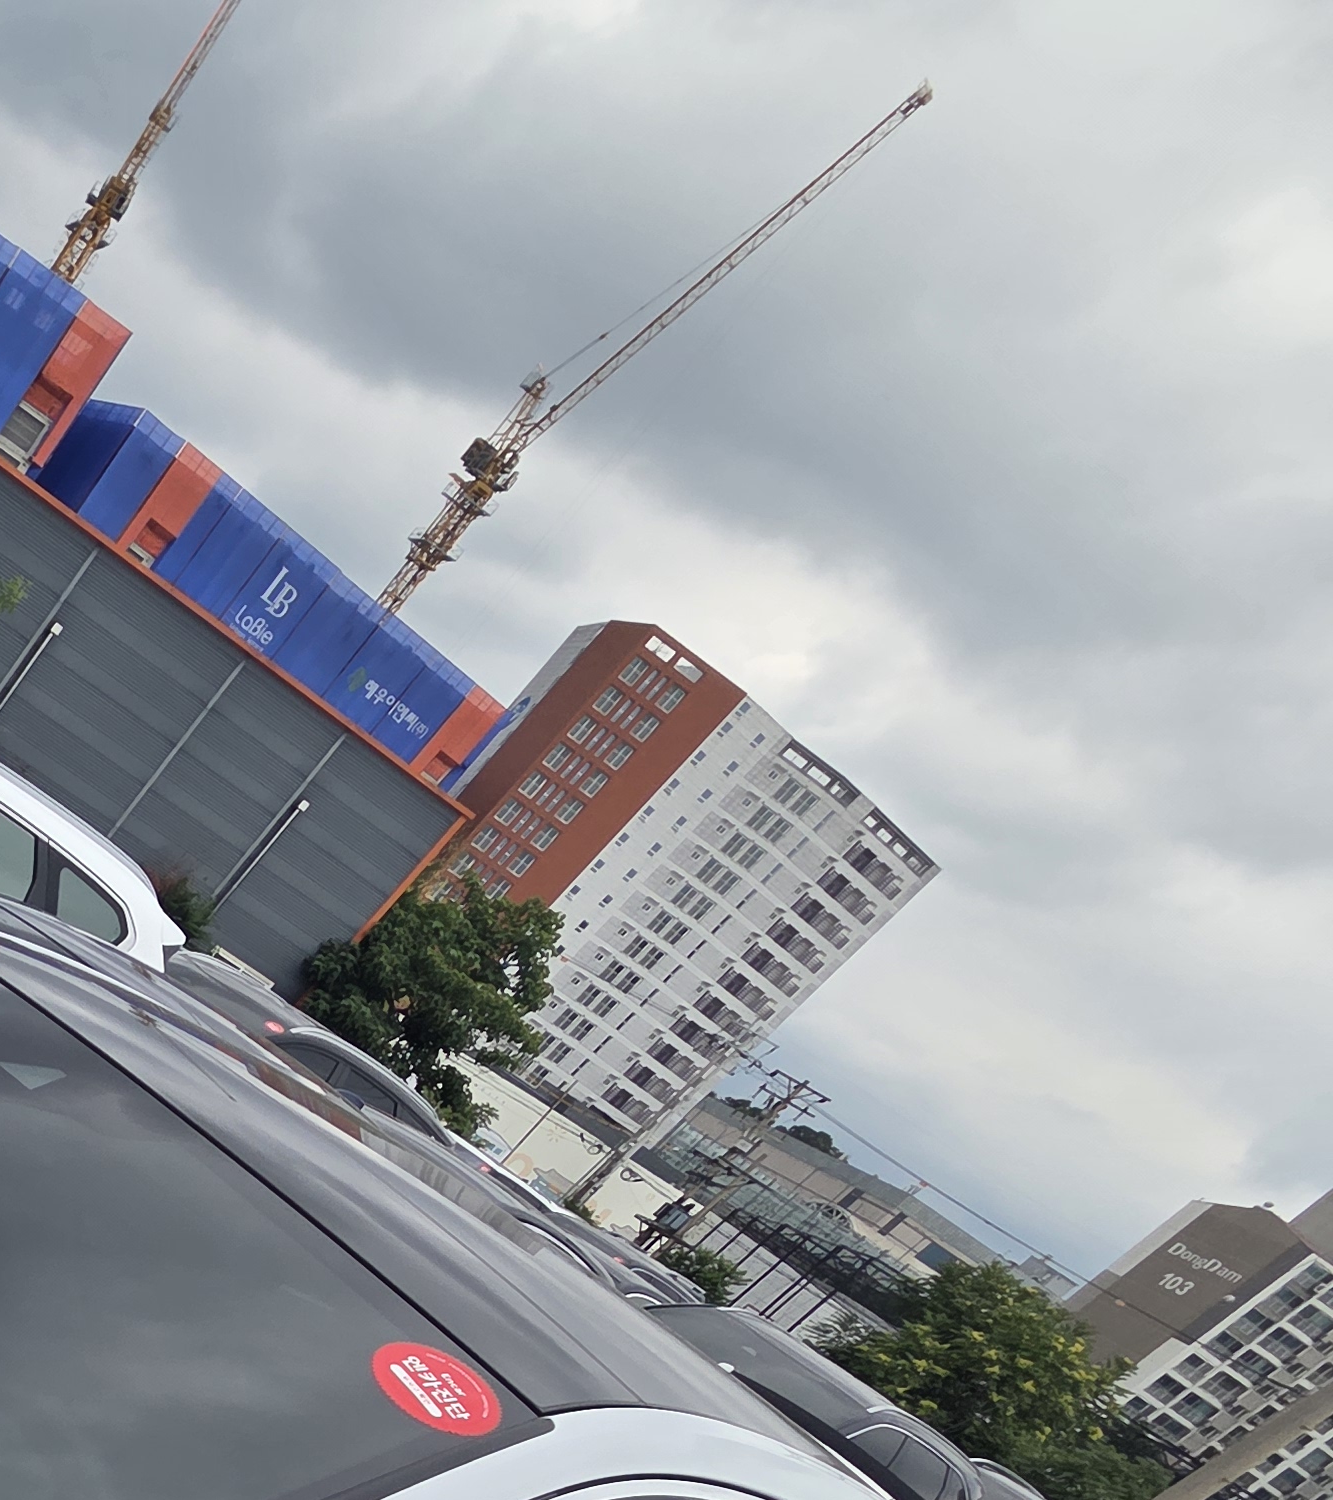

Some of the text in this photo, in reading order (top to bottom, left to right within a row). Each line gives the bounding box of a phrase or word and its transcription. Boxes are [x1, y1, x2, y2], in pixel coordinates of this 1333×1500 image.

[260, 566, 298, 618] LB
[234, 604, 274, 645] LaBie
[1167, 1242, 1243, 1284] DongDam
[1158, 1273, 1195, 1296] 103
[401, 1355, 471, 1420] 엔카진단
